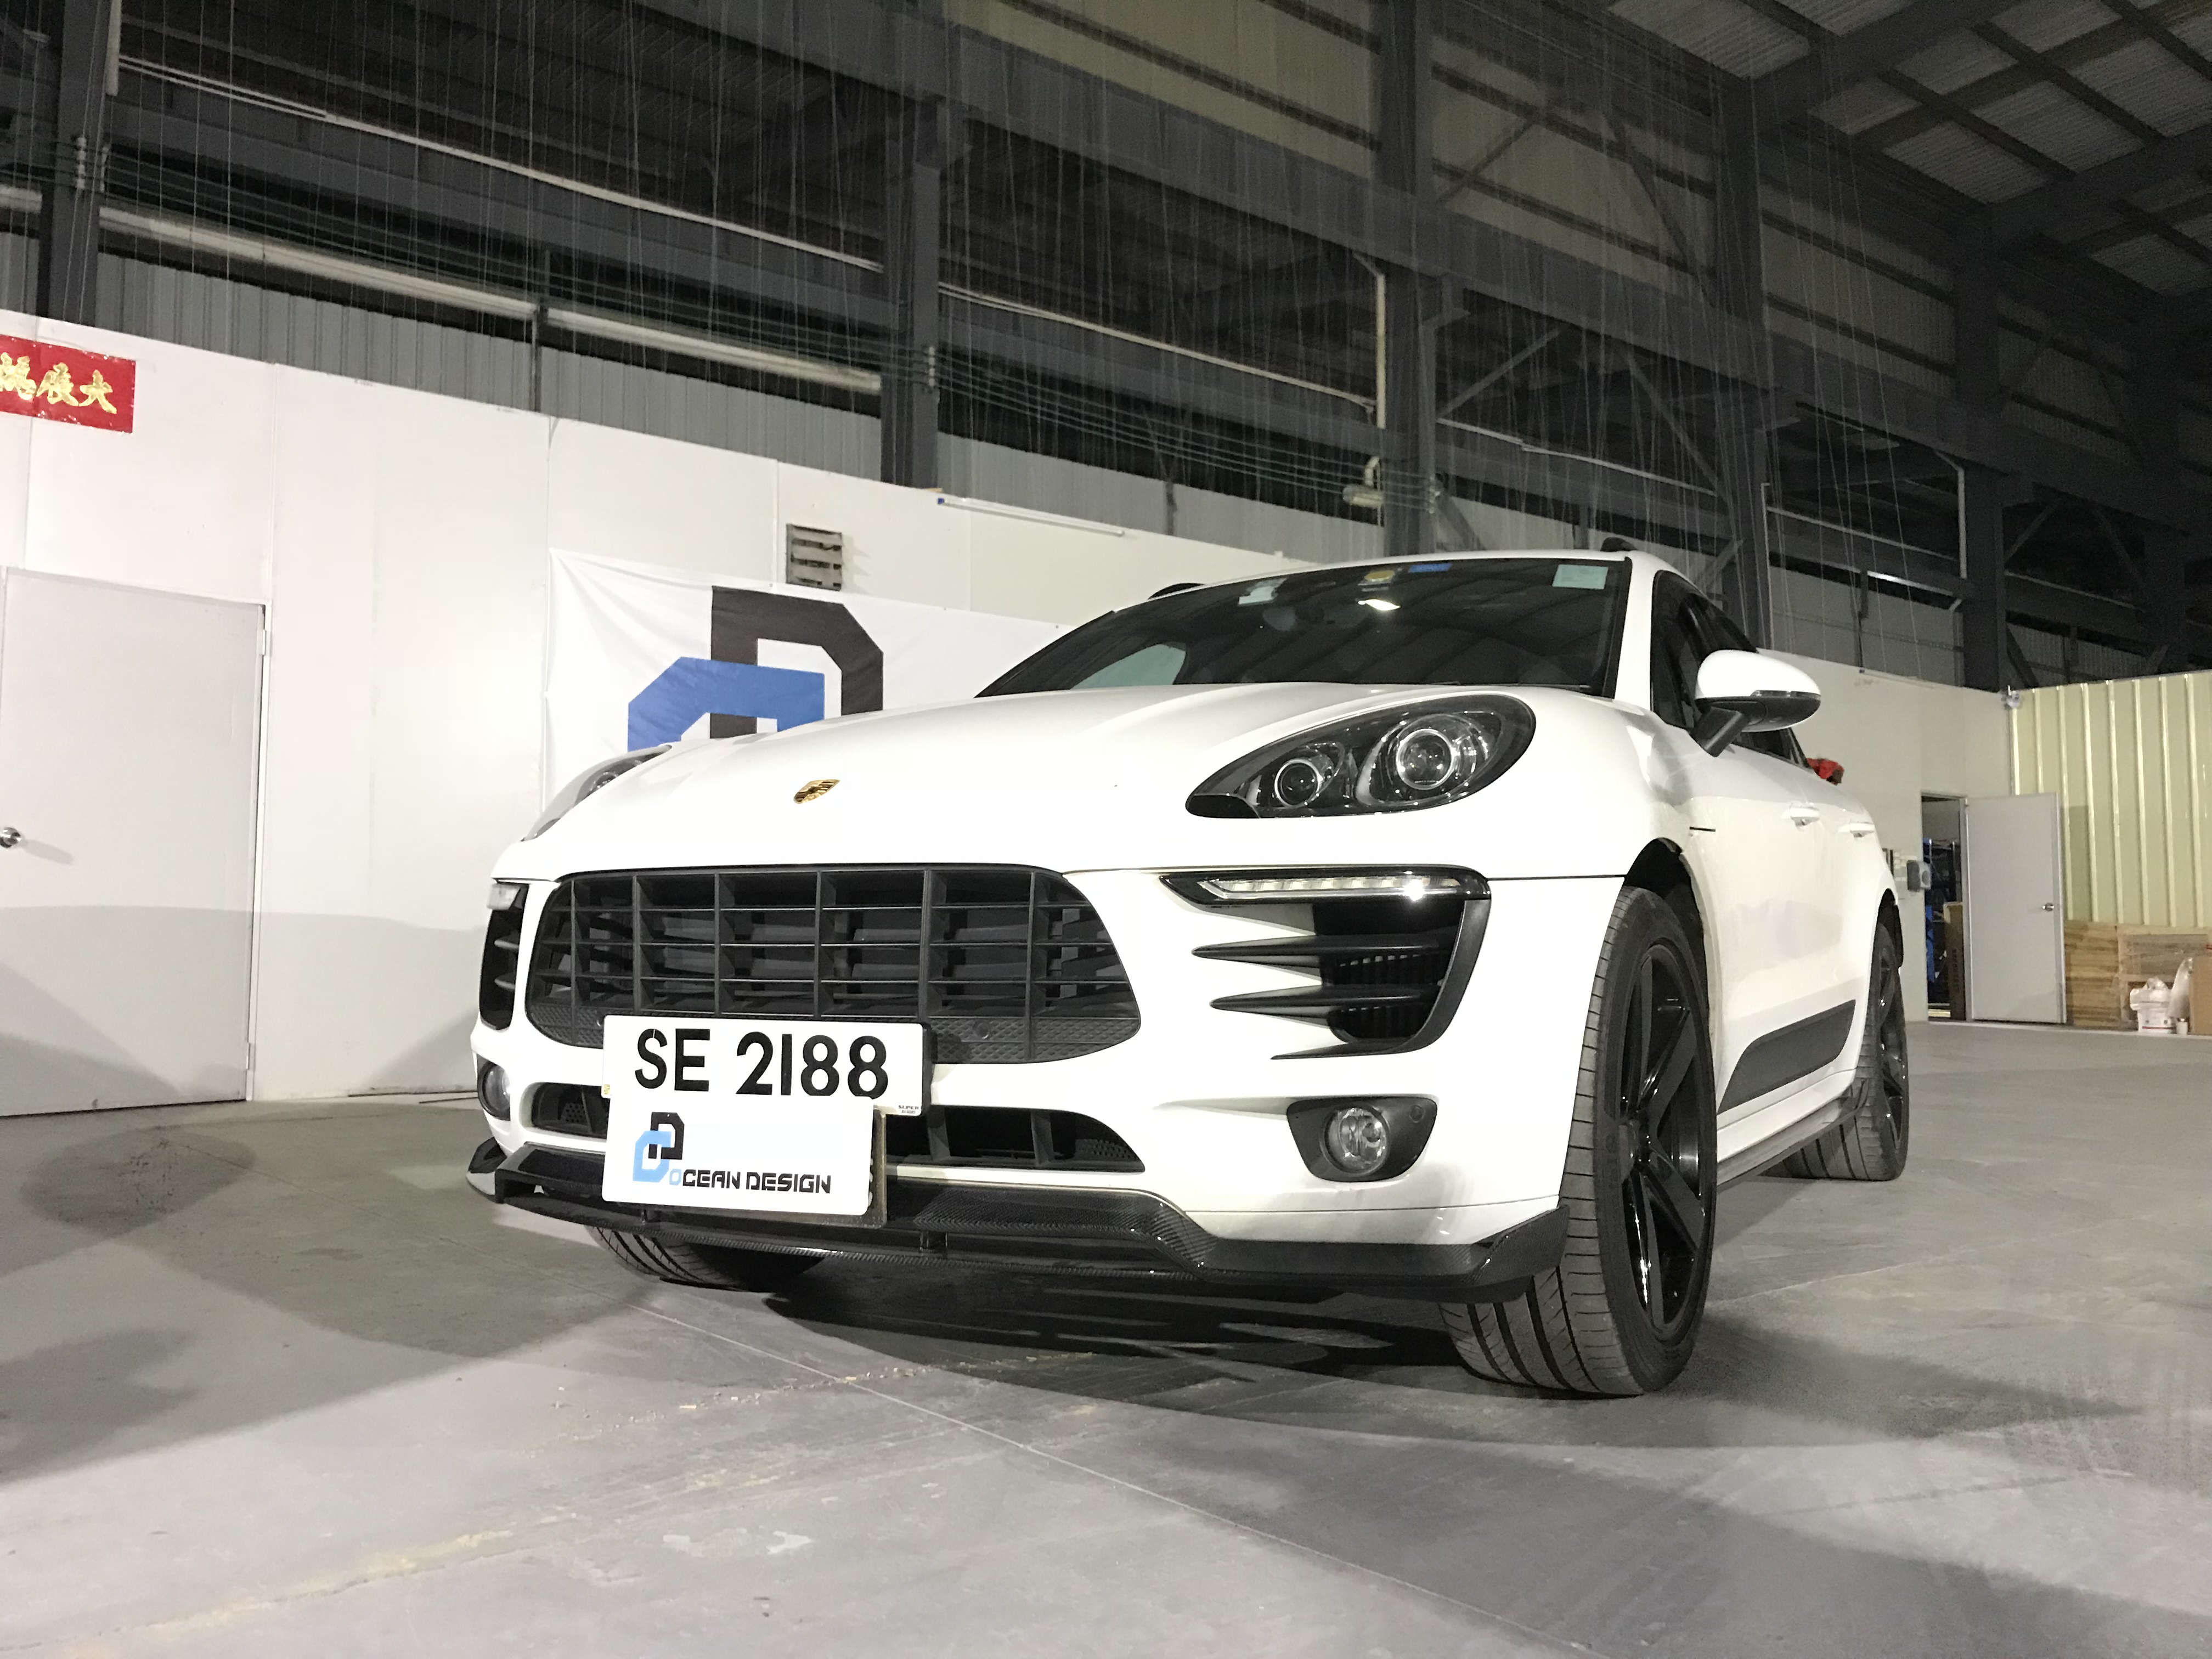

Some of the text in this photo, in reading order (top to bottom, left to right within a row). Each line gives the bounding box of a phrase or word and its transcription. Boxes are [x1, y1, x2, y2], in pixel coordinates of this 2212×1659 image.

[635, 1028, 889, 1100] SE 2188
[746, 1171, 831, 1194] DESIGN
